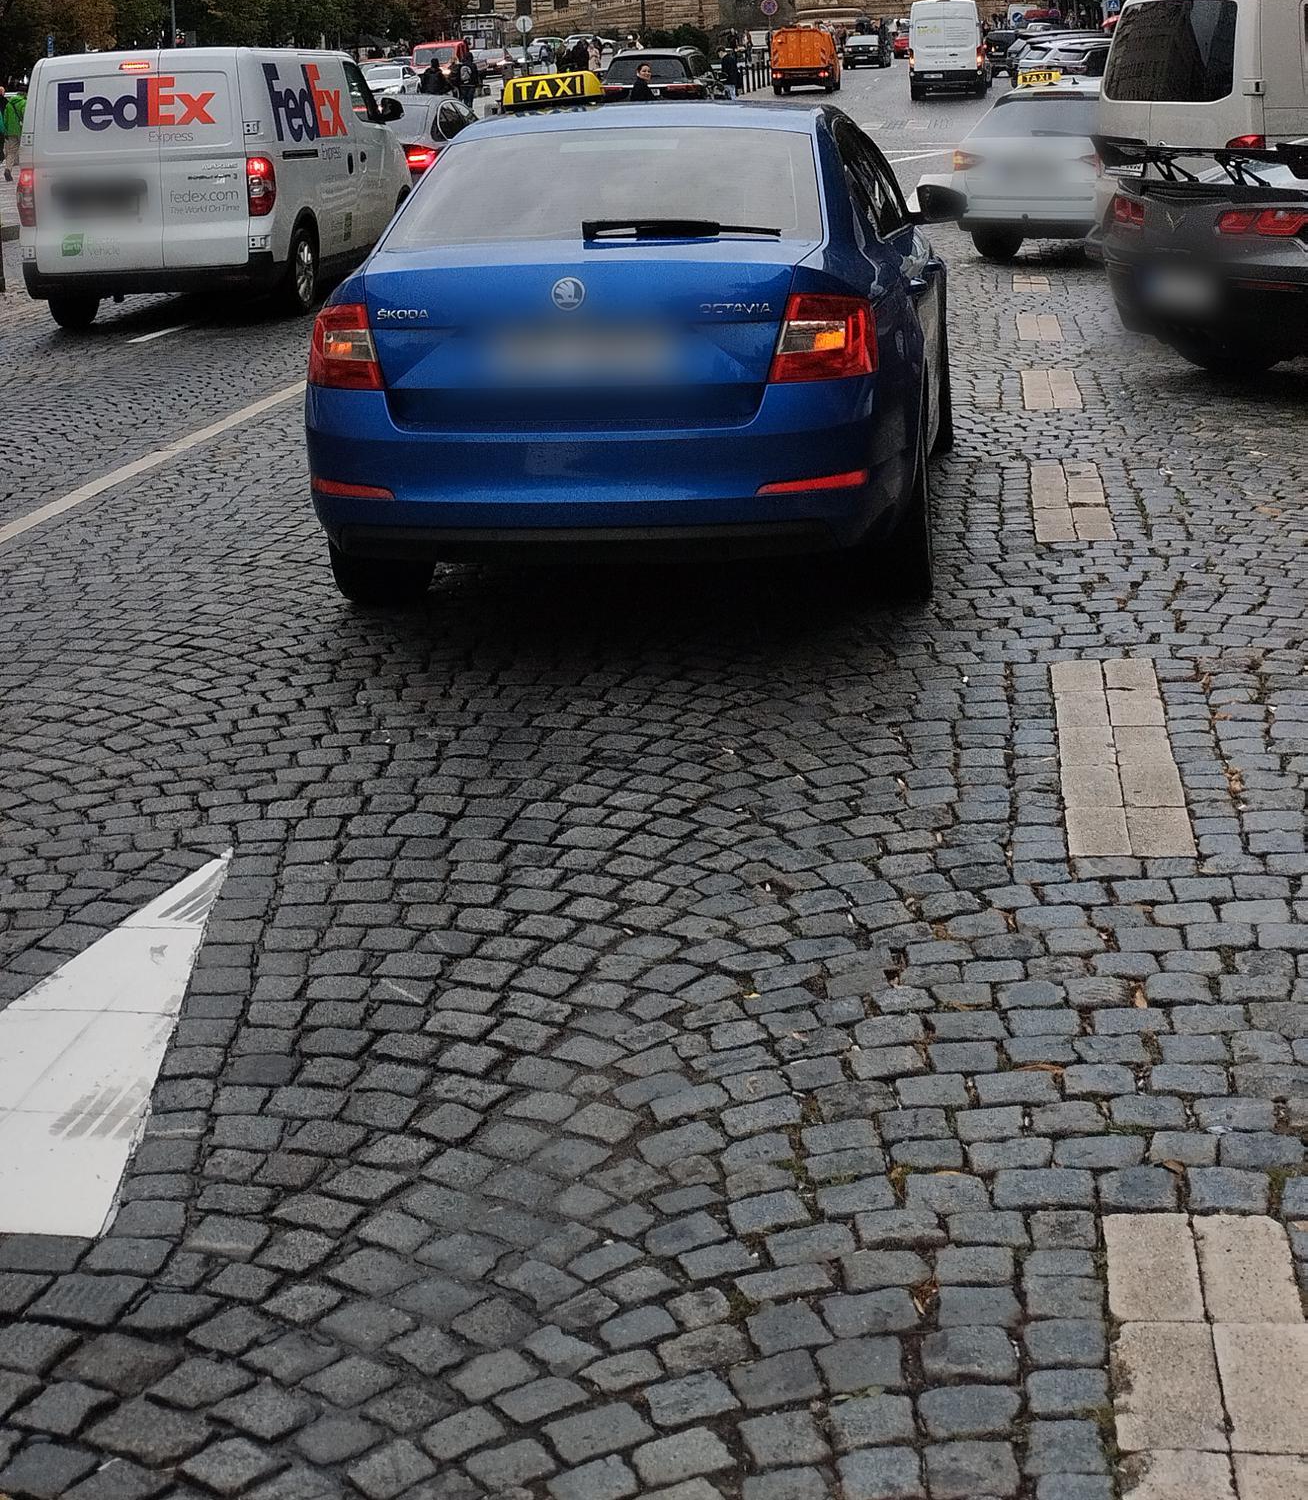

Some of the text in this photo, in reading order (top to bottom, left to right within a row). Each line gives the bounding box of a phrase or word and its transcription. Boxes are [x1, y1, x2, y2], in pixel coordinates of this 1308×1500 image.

[1025, 73, 1050, 83] TAXI
[515, 76, 581, 101] TAXI
[57, 76, 216, 132] FedEx
[262, 63, 348, 142] FedEx
[148, 131, 194, 143] Express
[170, 189, 239, 203] fedex.com
[377, 308, 429, 320] ŠKODA
[699, 302, 772, 314] OCTAVIA
